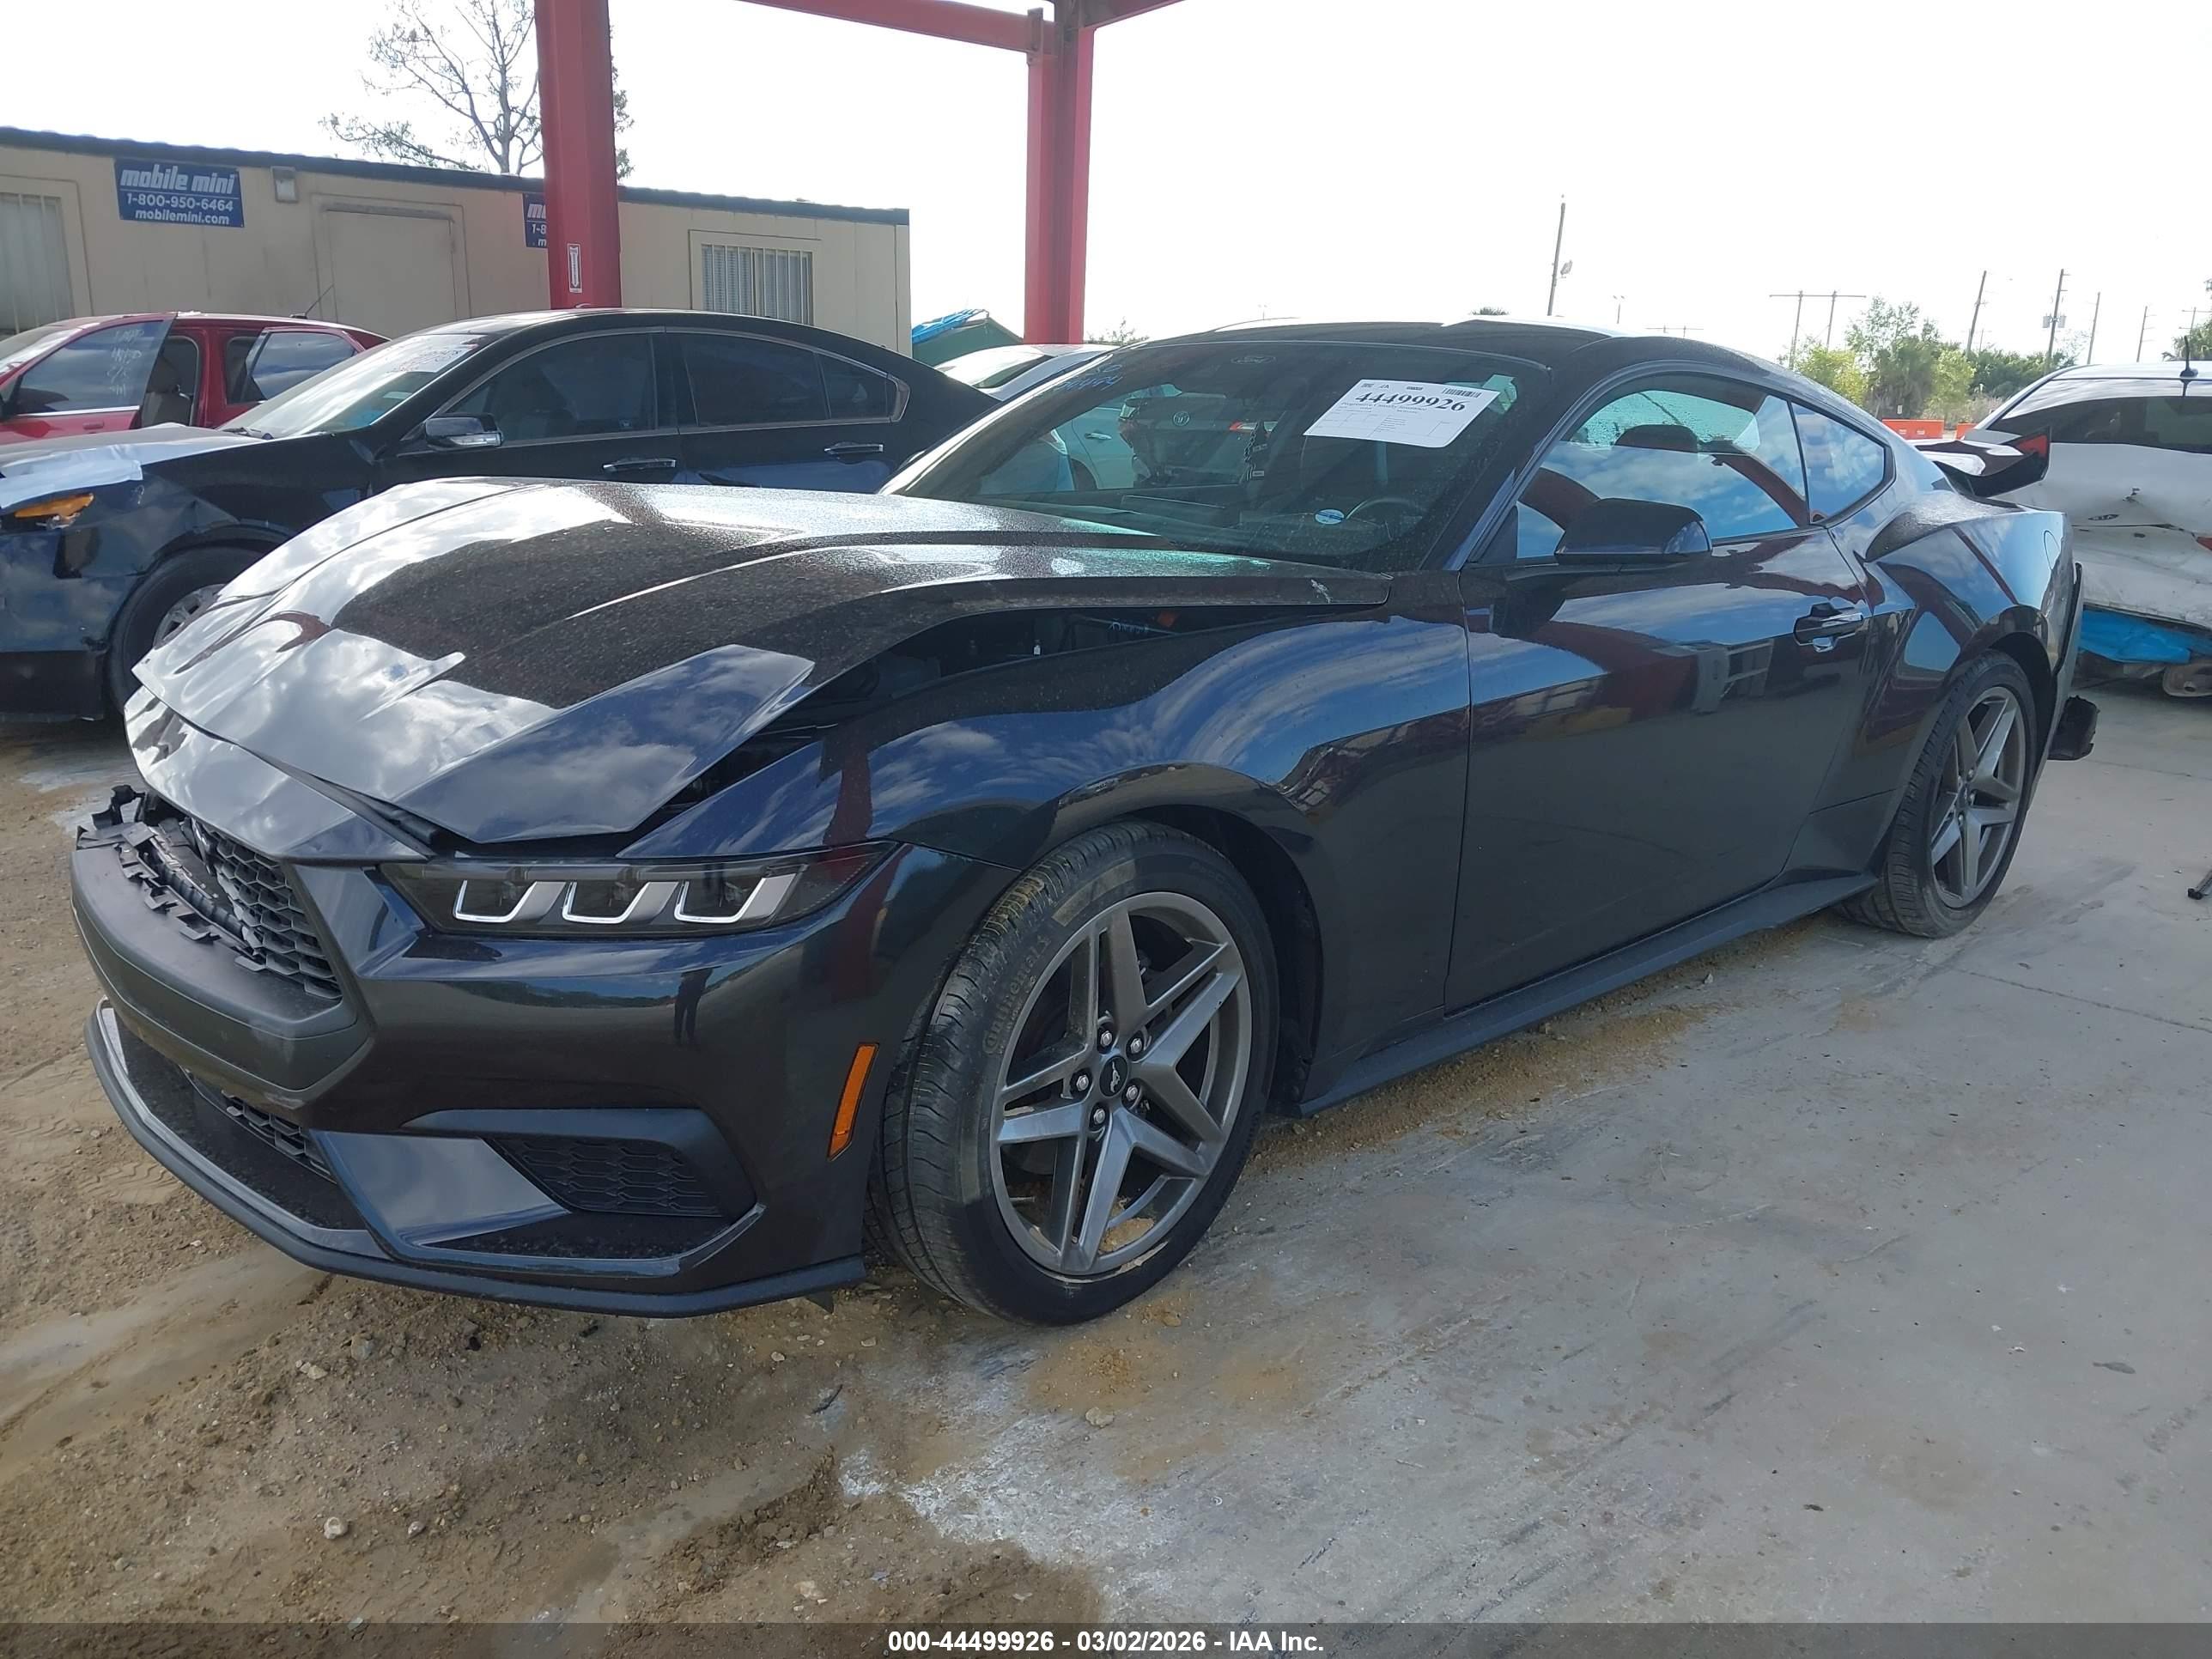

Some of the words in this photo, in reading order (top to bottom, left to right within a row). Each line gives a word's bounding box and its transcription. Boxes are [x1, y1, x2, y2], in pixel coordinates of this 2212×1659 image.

[120, 164, 188, 191] mobile
[191, 172, 234, 194] mini
[127, 193, 234, 212] 1-800-950-6464
[135, 209, 230, 225] mobilemini.com
[1355, 392, 1470, 411] 44499926
